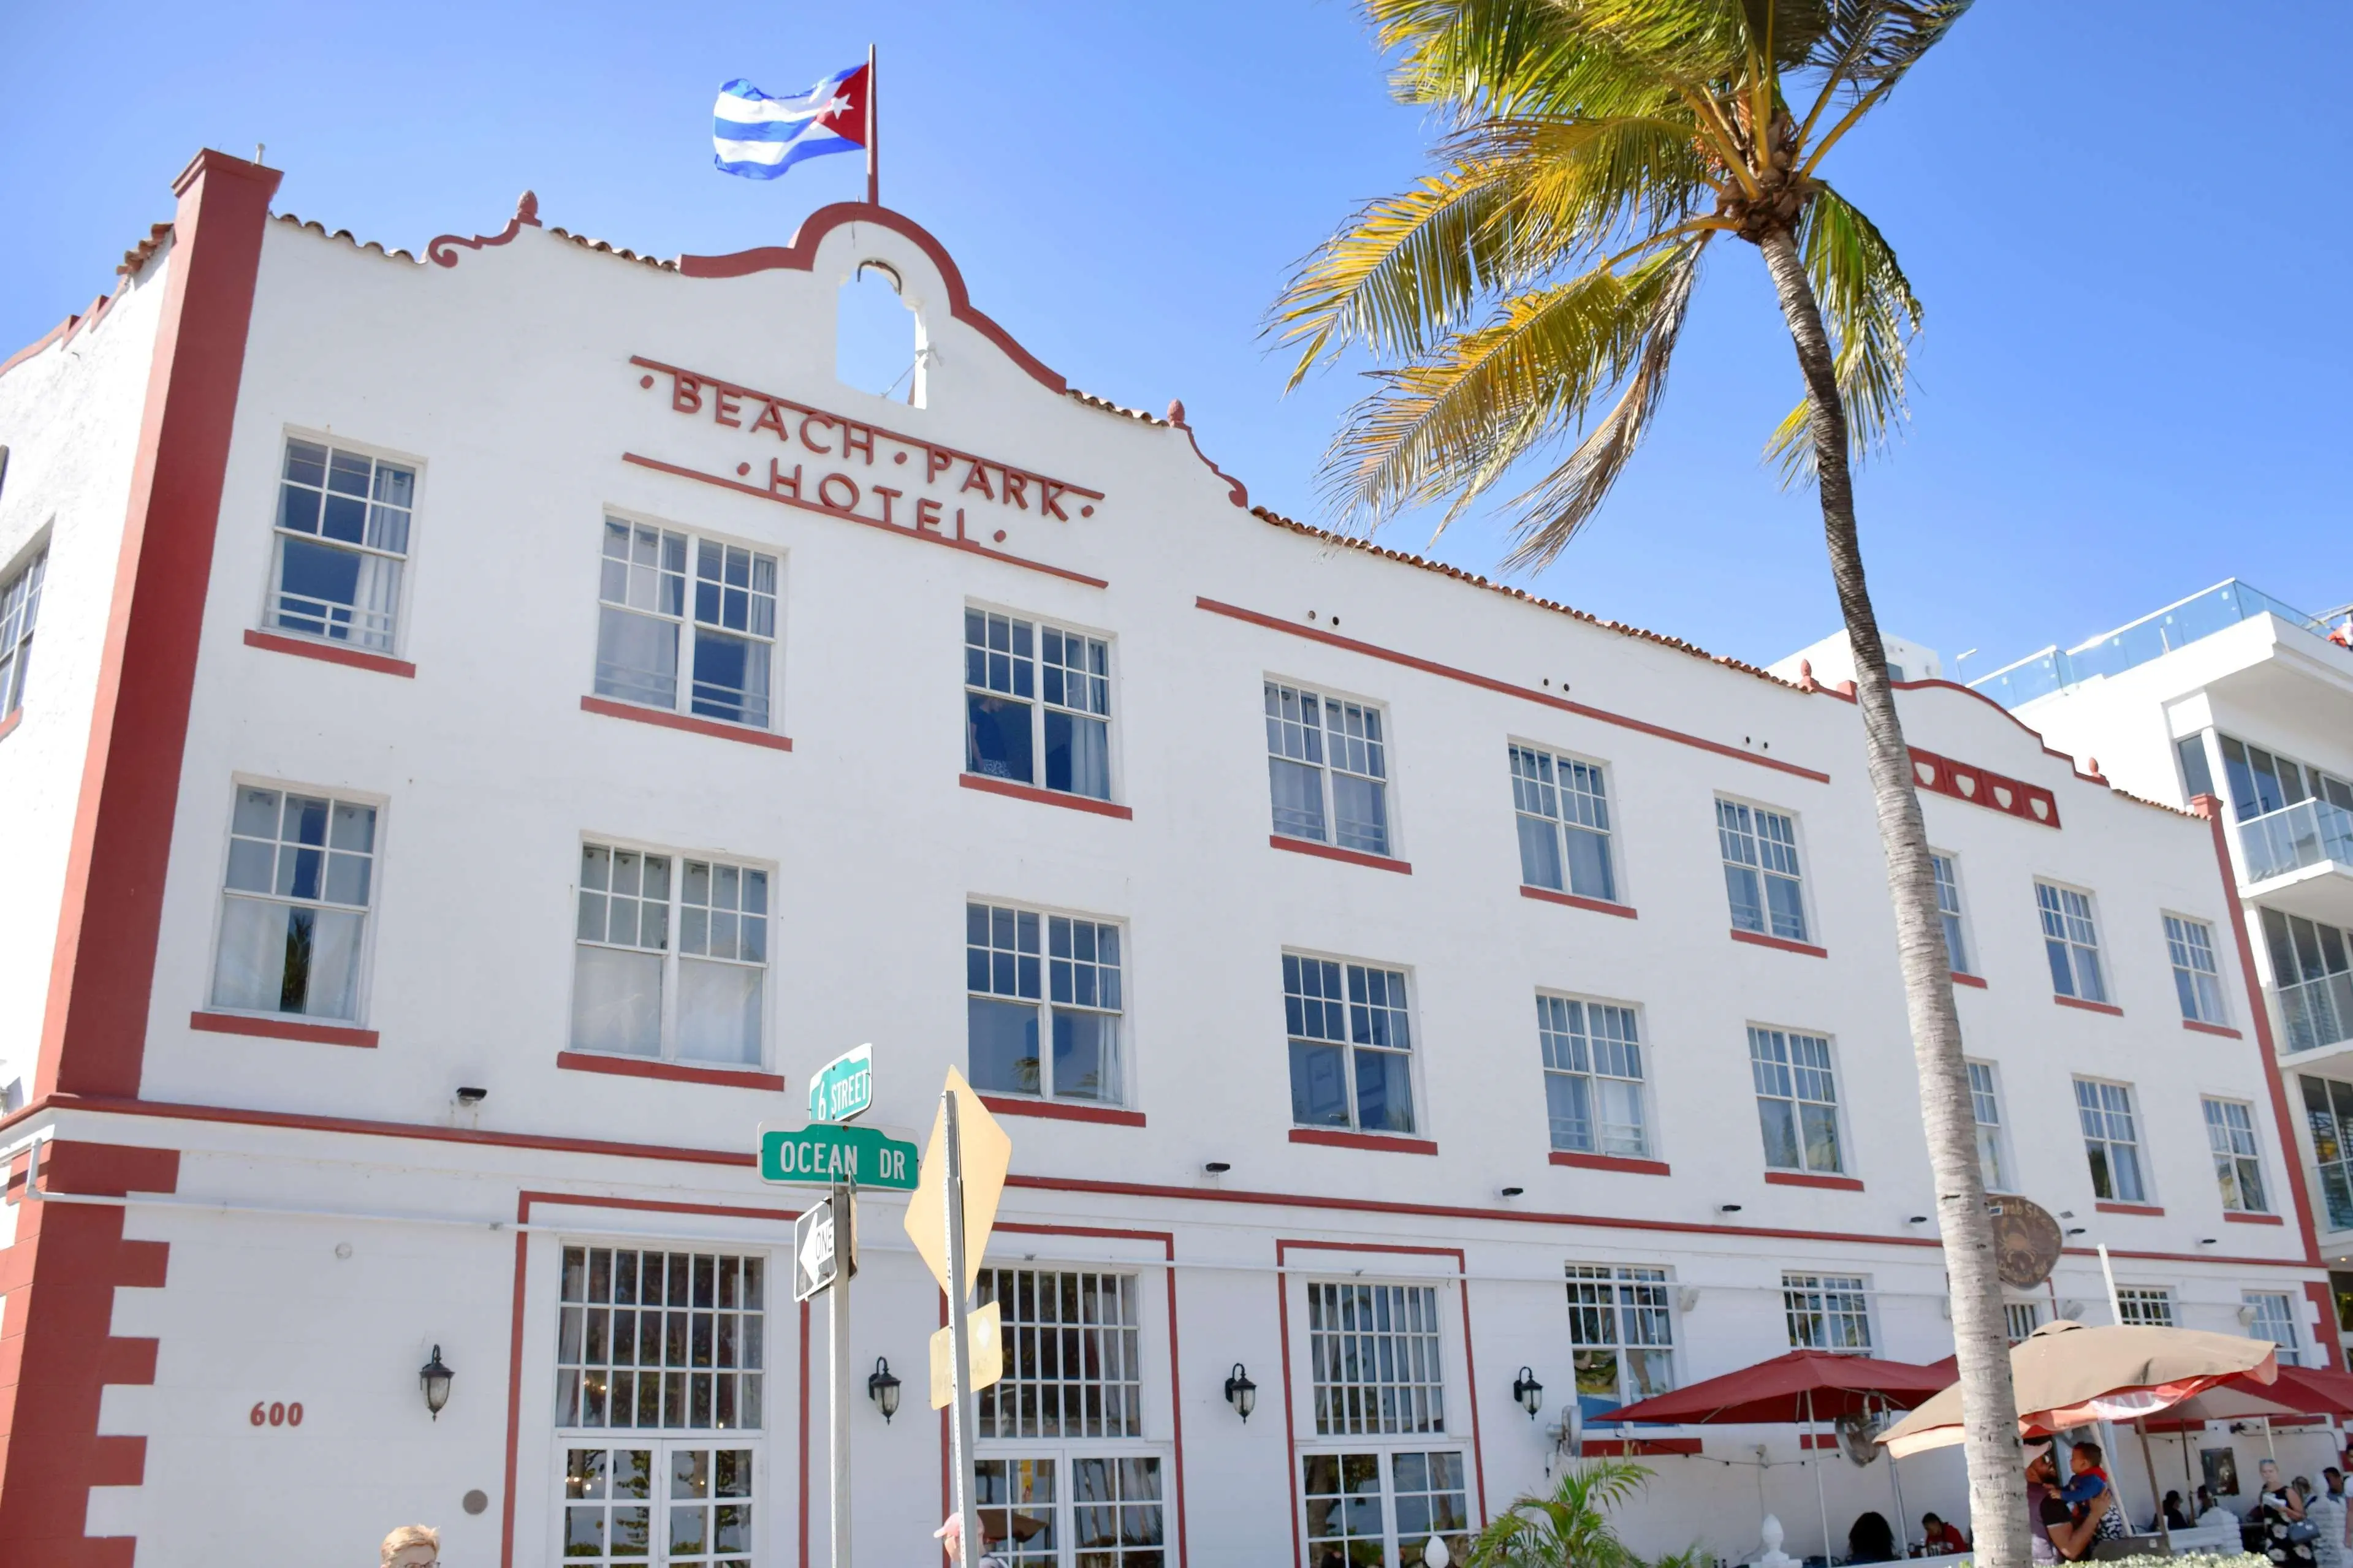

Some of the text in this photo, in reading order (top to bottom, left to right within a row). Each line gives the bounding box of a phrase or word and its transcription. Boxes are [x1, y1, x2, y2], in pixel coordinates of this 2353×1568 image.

[672, 371, 1069, 522] BEACH PARK
[770, 457, 981, 547] HOTEL
[818, 1069, 868, 1120] 6 STREET
[780, 1141, 905, 1180] OCEAN DR
[816, 1224, 833, 1260] ONE
[250, 1401, 303, 1426] 600
